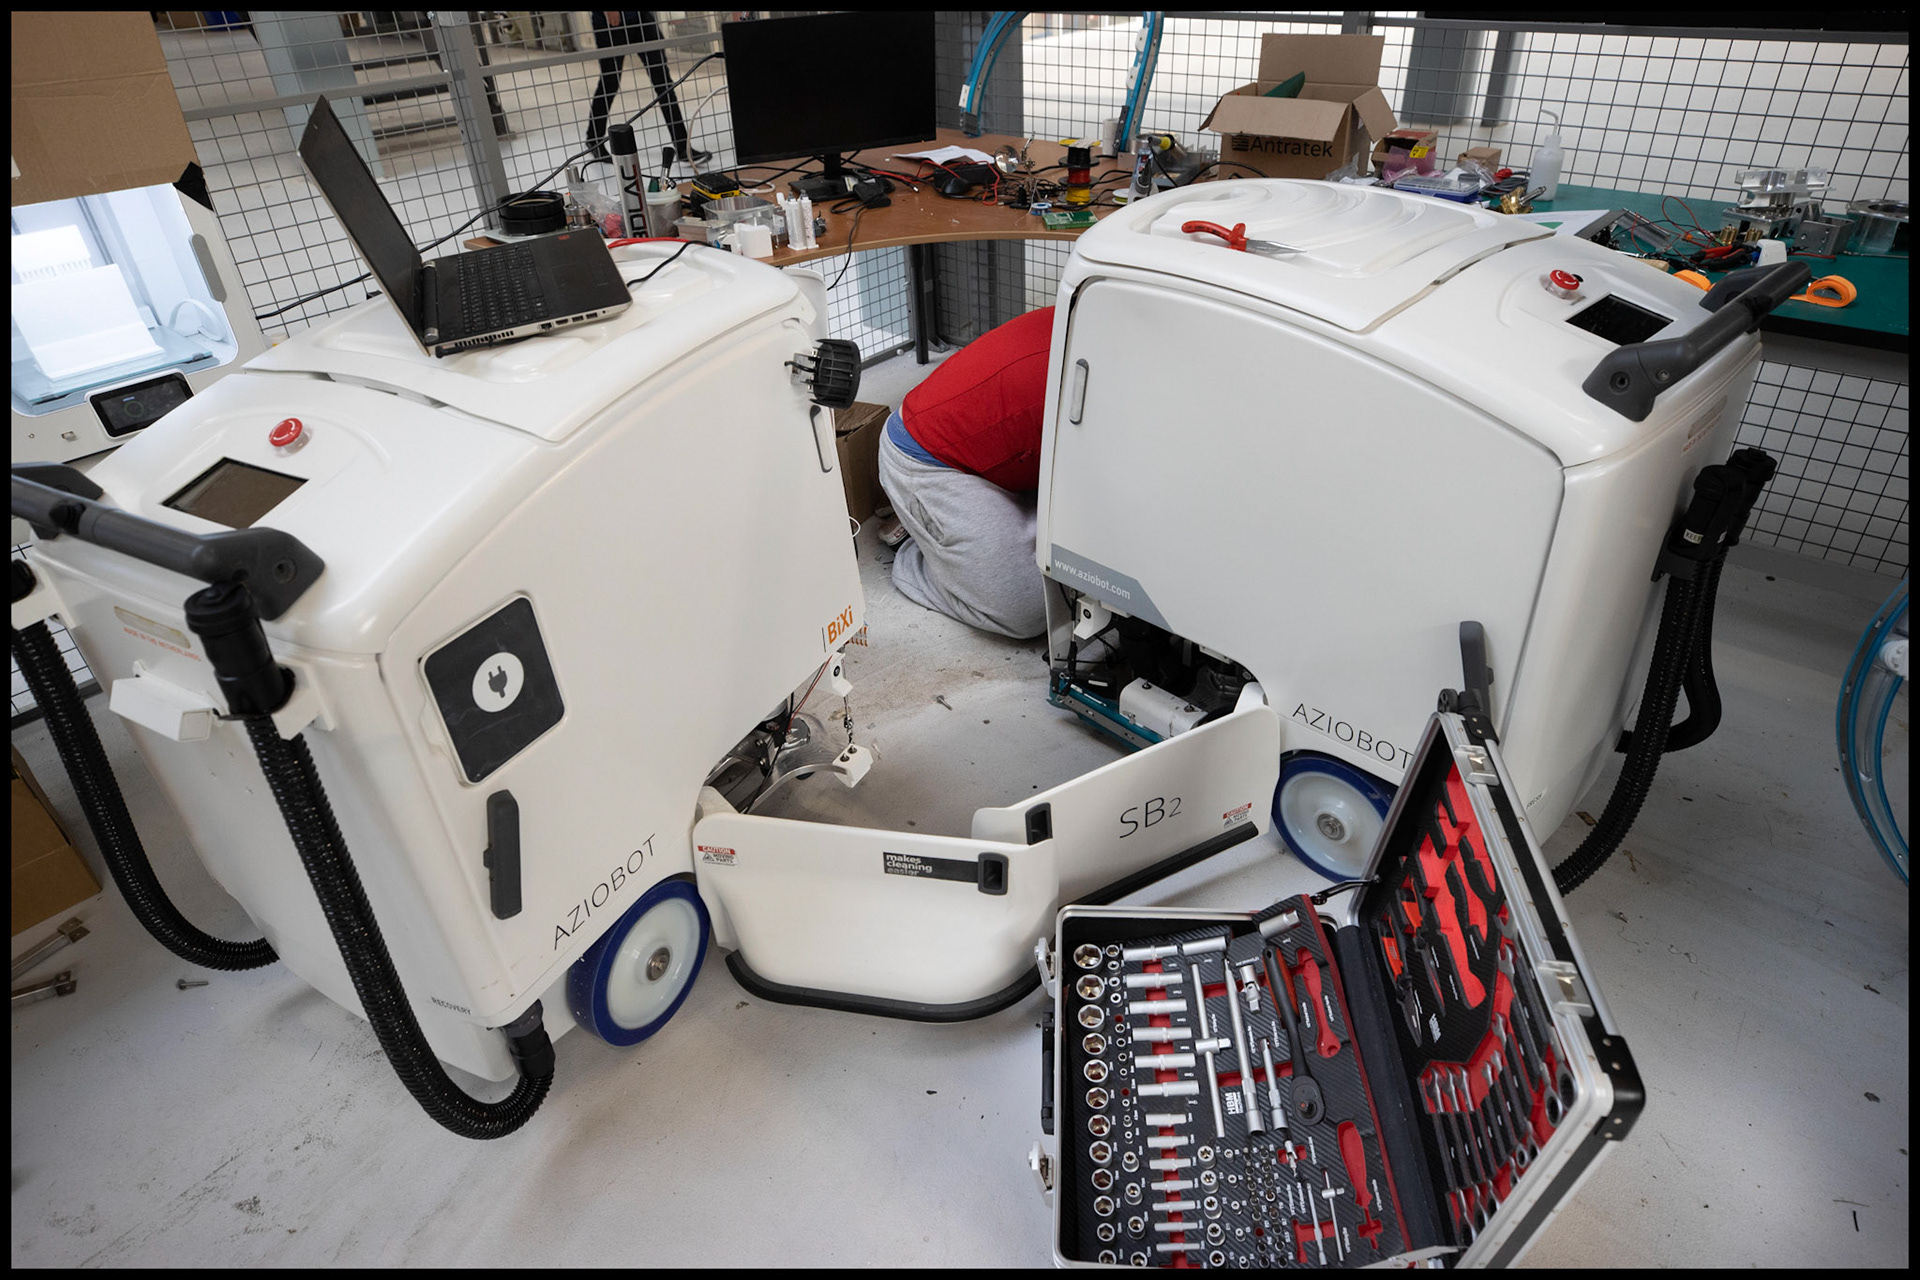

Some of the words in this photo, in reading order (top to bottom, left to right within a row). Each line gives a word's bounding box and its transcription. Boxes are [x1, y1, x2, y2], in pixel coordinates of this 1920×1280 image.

[1250, 136, 1333, 158] Antratek
[1054, 559, 1131, 600] www.aziobot.com
[827, 604, 853, 645] BiXi
[1292, 703, 1415, 769] AZIOBOT
[1119, 797, 1182, 839] SB2
[702, 846, 731, 855] CAUTION
[886, 854, 921, 864] makes
[886, 861, 933, 873] cleaning
[887, 867, 920, 876] easier
[554, 833, 656, 951] AZIOBOT
[431, 996, 471, 1015] RECOVERY
[1225, 1091, 1236, 1115] HBM
